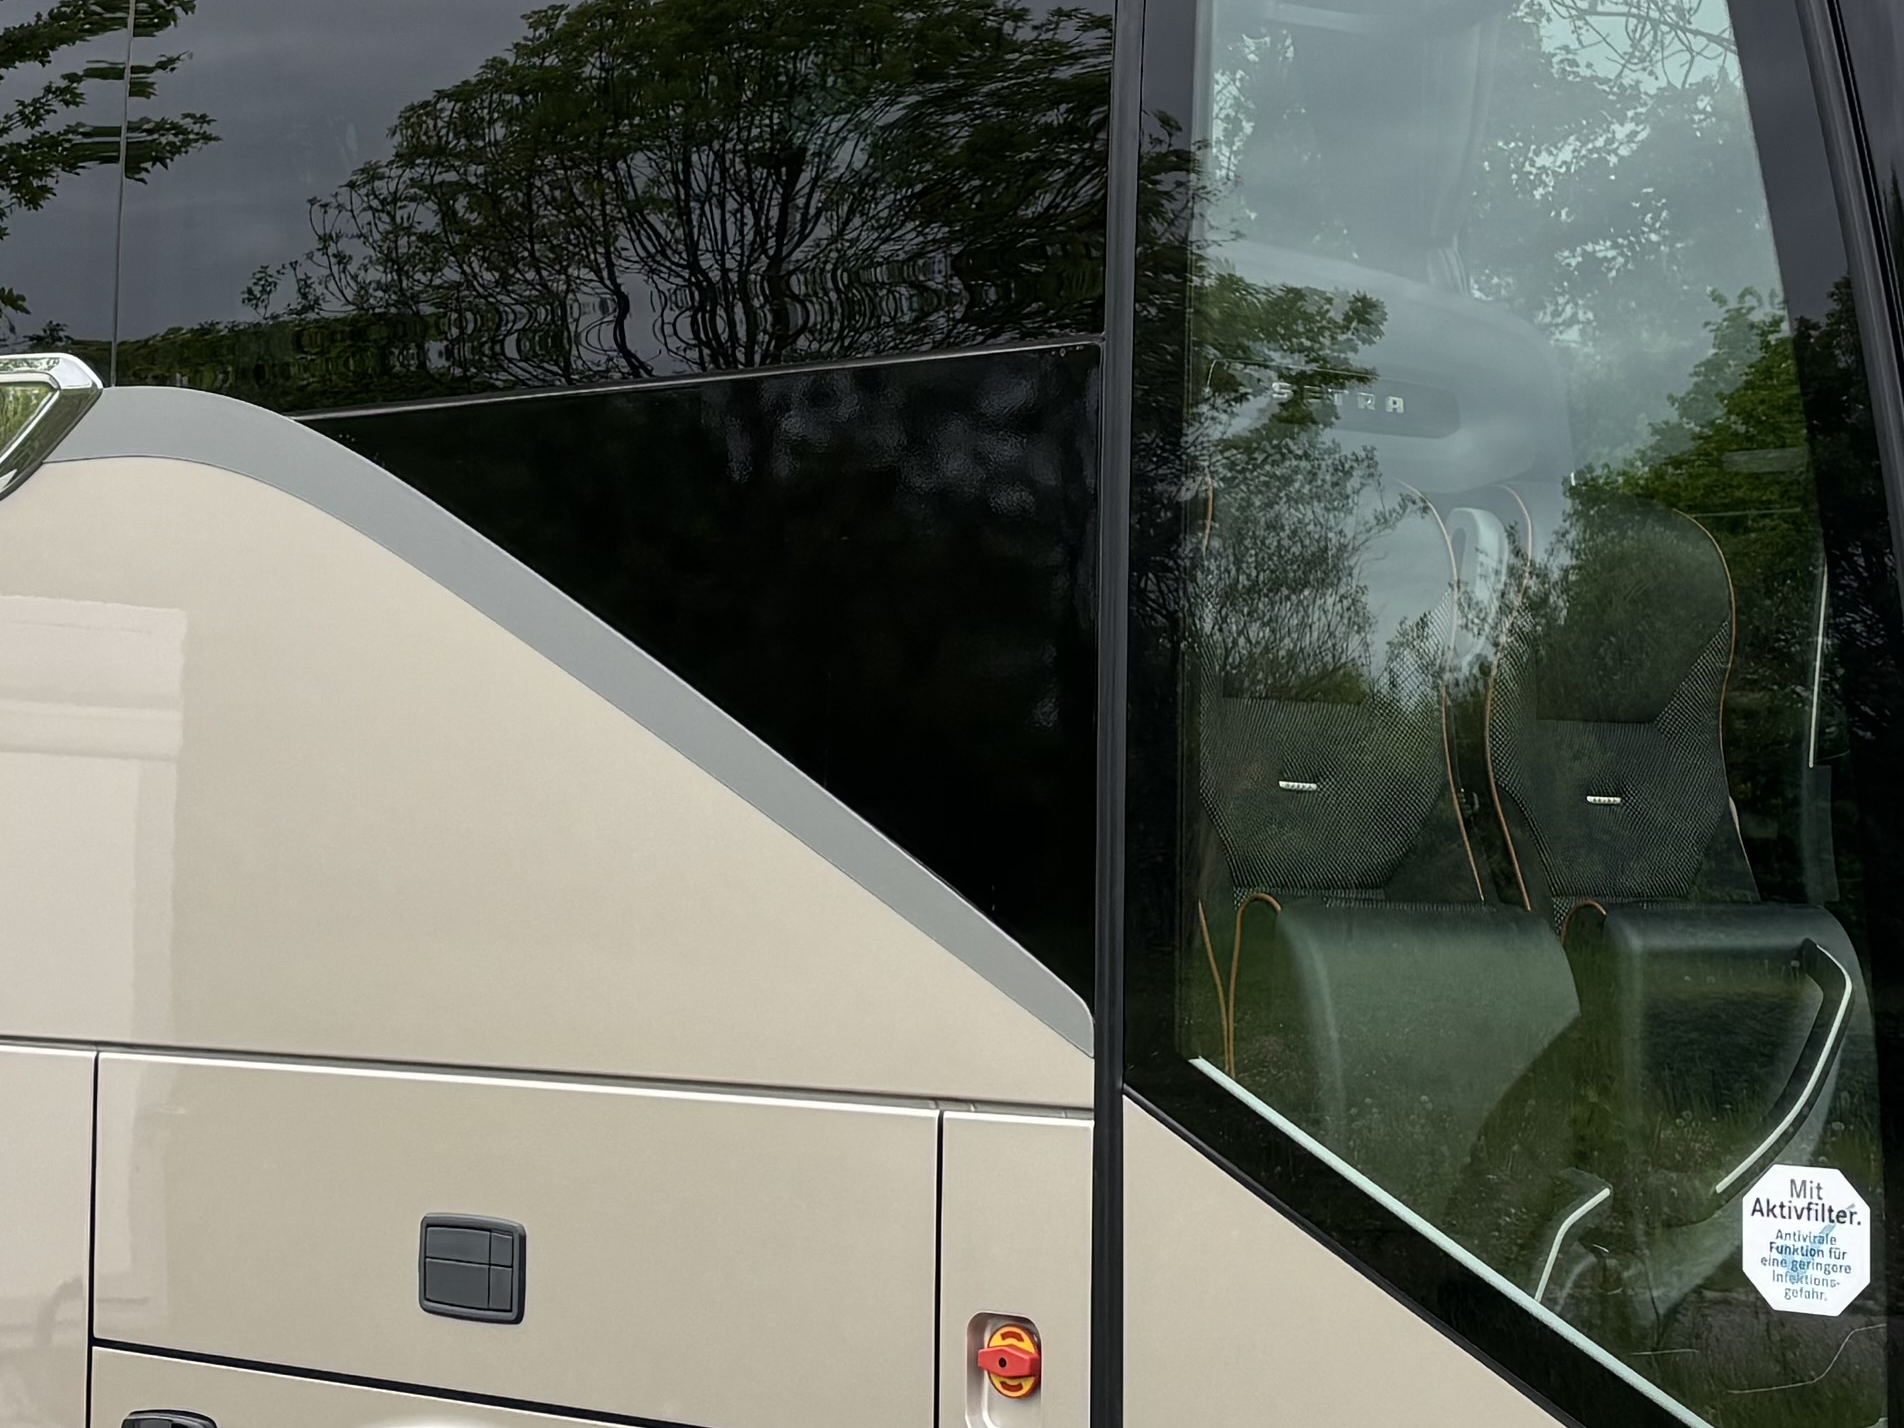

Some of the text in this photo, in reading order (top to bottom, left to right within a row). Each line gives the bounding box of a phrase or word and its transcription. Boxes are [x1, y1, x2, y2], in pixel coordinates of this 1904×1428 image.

[1272, 382, 1404, 413] SETRA
[1790, 1178, 1823, 1200] Mit
[1751, 1197, 1862, 1226] Aktivfilter.
[1775, 1229, 1837, 1246] Antivirale
[1769, 1242, 1847, 1260] Funktion für
[1760, 1253, 1852, 1275] eine geringere
[1772, 1270, 1840, 1288] Infektions-
[1783, 1287, 1827, 1301] gefahr.
